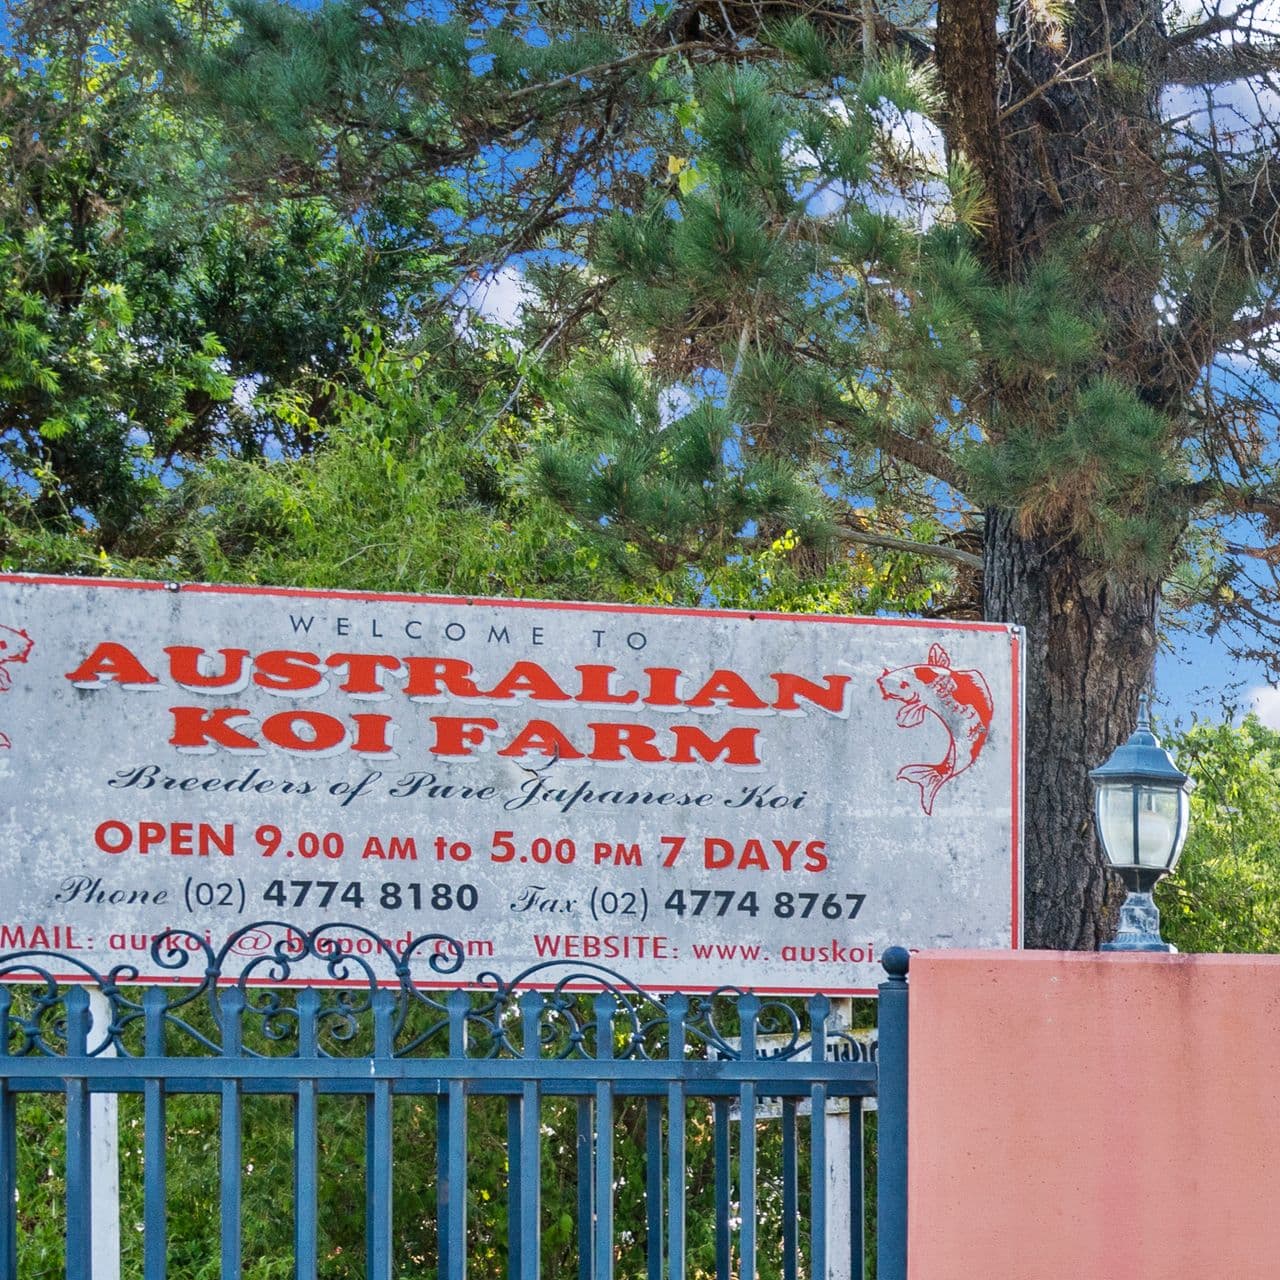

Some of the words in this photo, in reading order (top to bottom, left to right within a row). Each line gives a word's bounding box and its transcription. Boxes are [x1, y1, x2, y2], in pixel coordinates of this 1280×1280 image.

[290, 614, 545, 646] WELCOME
[592, 629, 648, 651] TO
[65, 641, 852, 713] AUSTRALIAN
[168, 706, 394, 754] KOI
[429, 715, 761, 765] FARM
[107, 765, 318, 797] Breeders
[328, 771, 384, 806] of
[388, 771, 500, 802] Pure
[503, 774, 713, 814] Japanese
[723, 785, 809, 811] Koi
[94, 819, 235, 858] OPEN
[255, 824, 345, 860] 9.00
[362, 836, 418, 861] AM
[434, 836, 472, 862] to
[490, 830, 577, 866] 5.00
[593, 841, 643, 867] PM
[660, 835, 687, 867] 7
[703, 837, 829, 874] DAYS
[54, 874, 169, 907] Phone
[184, 876, 247, 914] (02)
[263, 879, 365, 909] 4774
[379, 882, 479, 913] 8180
[510, 884, 577, 914] Fax
[590, 885, 649, 922] (02)
[664, 889, 760, 919] 4774
[774, 892, 867, 921] 8767
[286, 927, 422, 956] bgpond.
[533, 934, 680, 962] WEBSITE:
